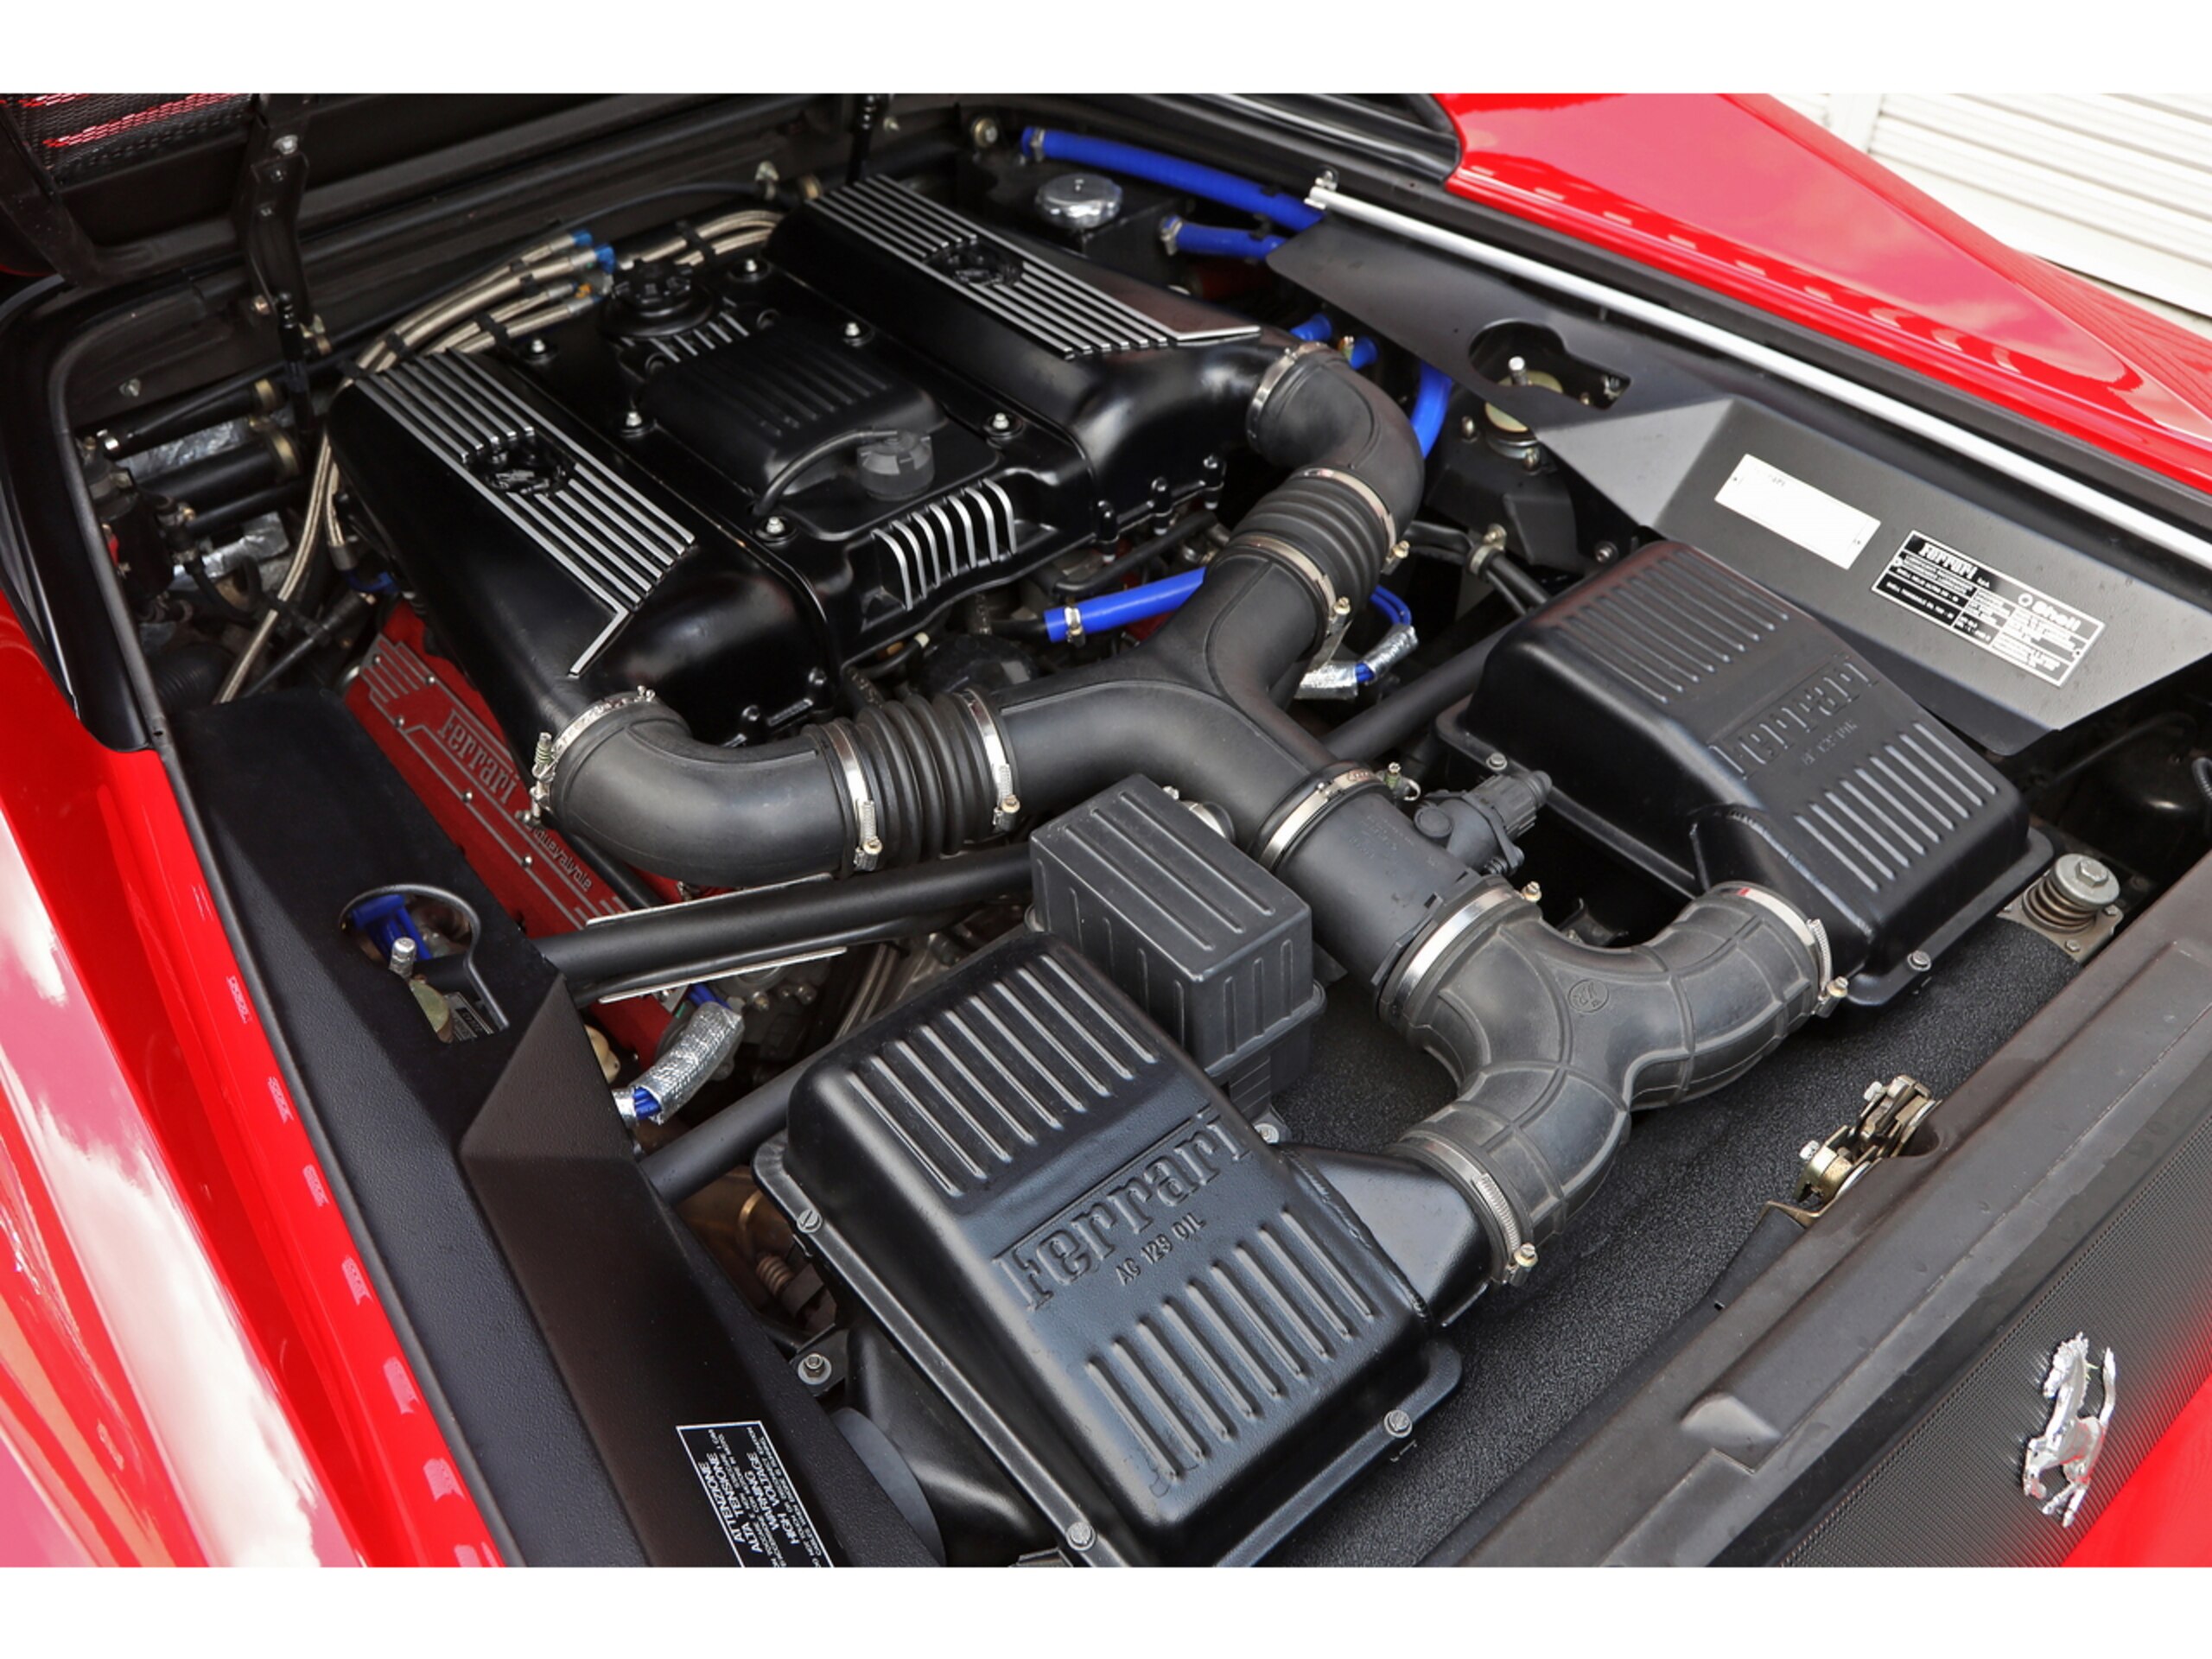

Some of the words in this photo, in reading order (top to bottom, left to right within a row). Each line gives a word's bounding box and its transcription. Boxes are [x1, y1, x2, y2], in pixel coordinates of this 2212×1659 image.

[1918, 542, 1978, 579] Ferrari
[2032, 598, 2082, 632] Shell
[1707, 656, 1879, 779] Ferrari
[436, 709, 519, 804] Ferrari
[992, 1107, 1253, 1313] Ferrari
[1141, 1233, 1173, 1265] 129
[698, 1461, 746, 1543] ATTENZIONE
[707, 1452, 744, 1518] TENSIONE
[744, 1471, 779, 1530] WARNING
[747, 1452, 779, 1507] VOLTAGE
[741, 1522, 762, 1553] ALTA
[778, 1513, 800, 1544] HIGH
